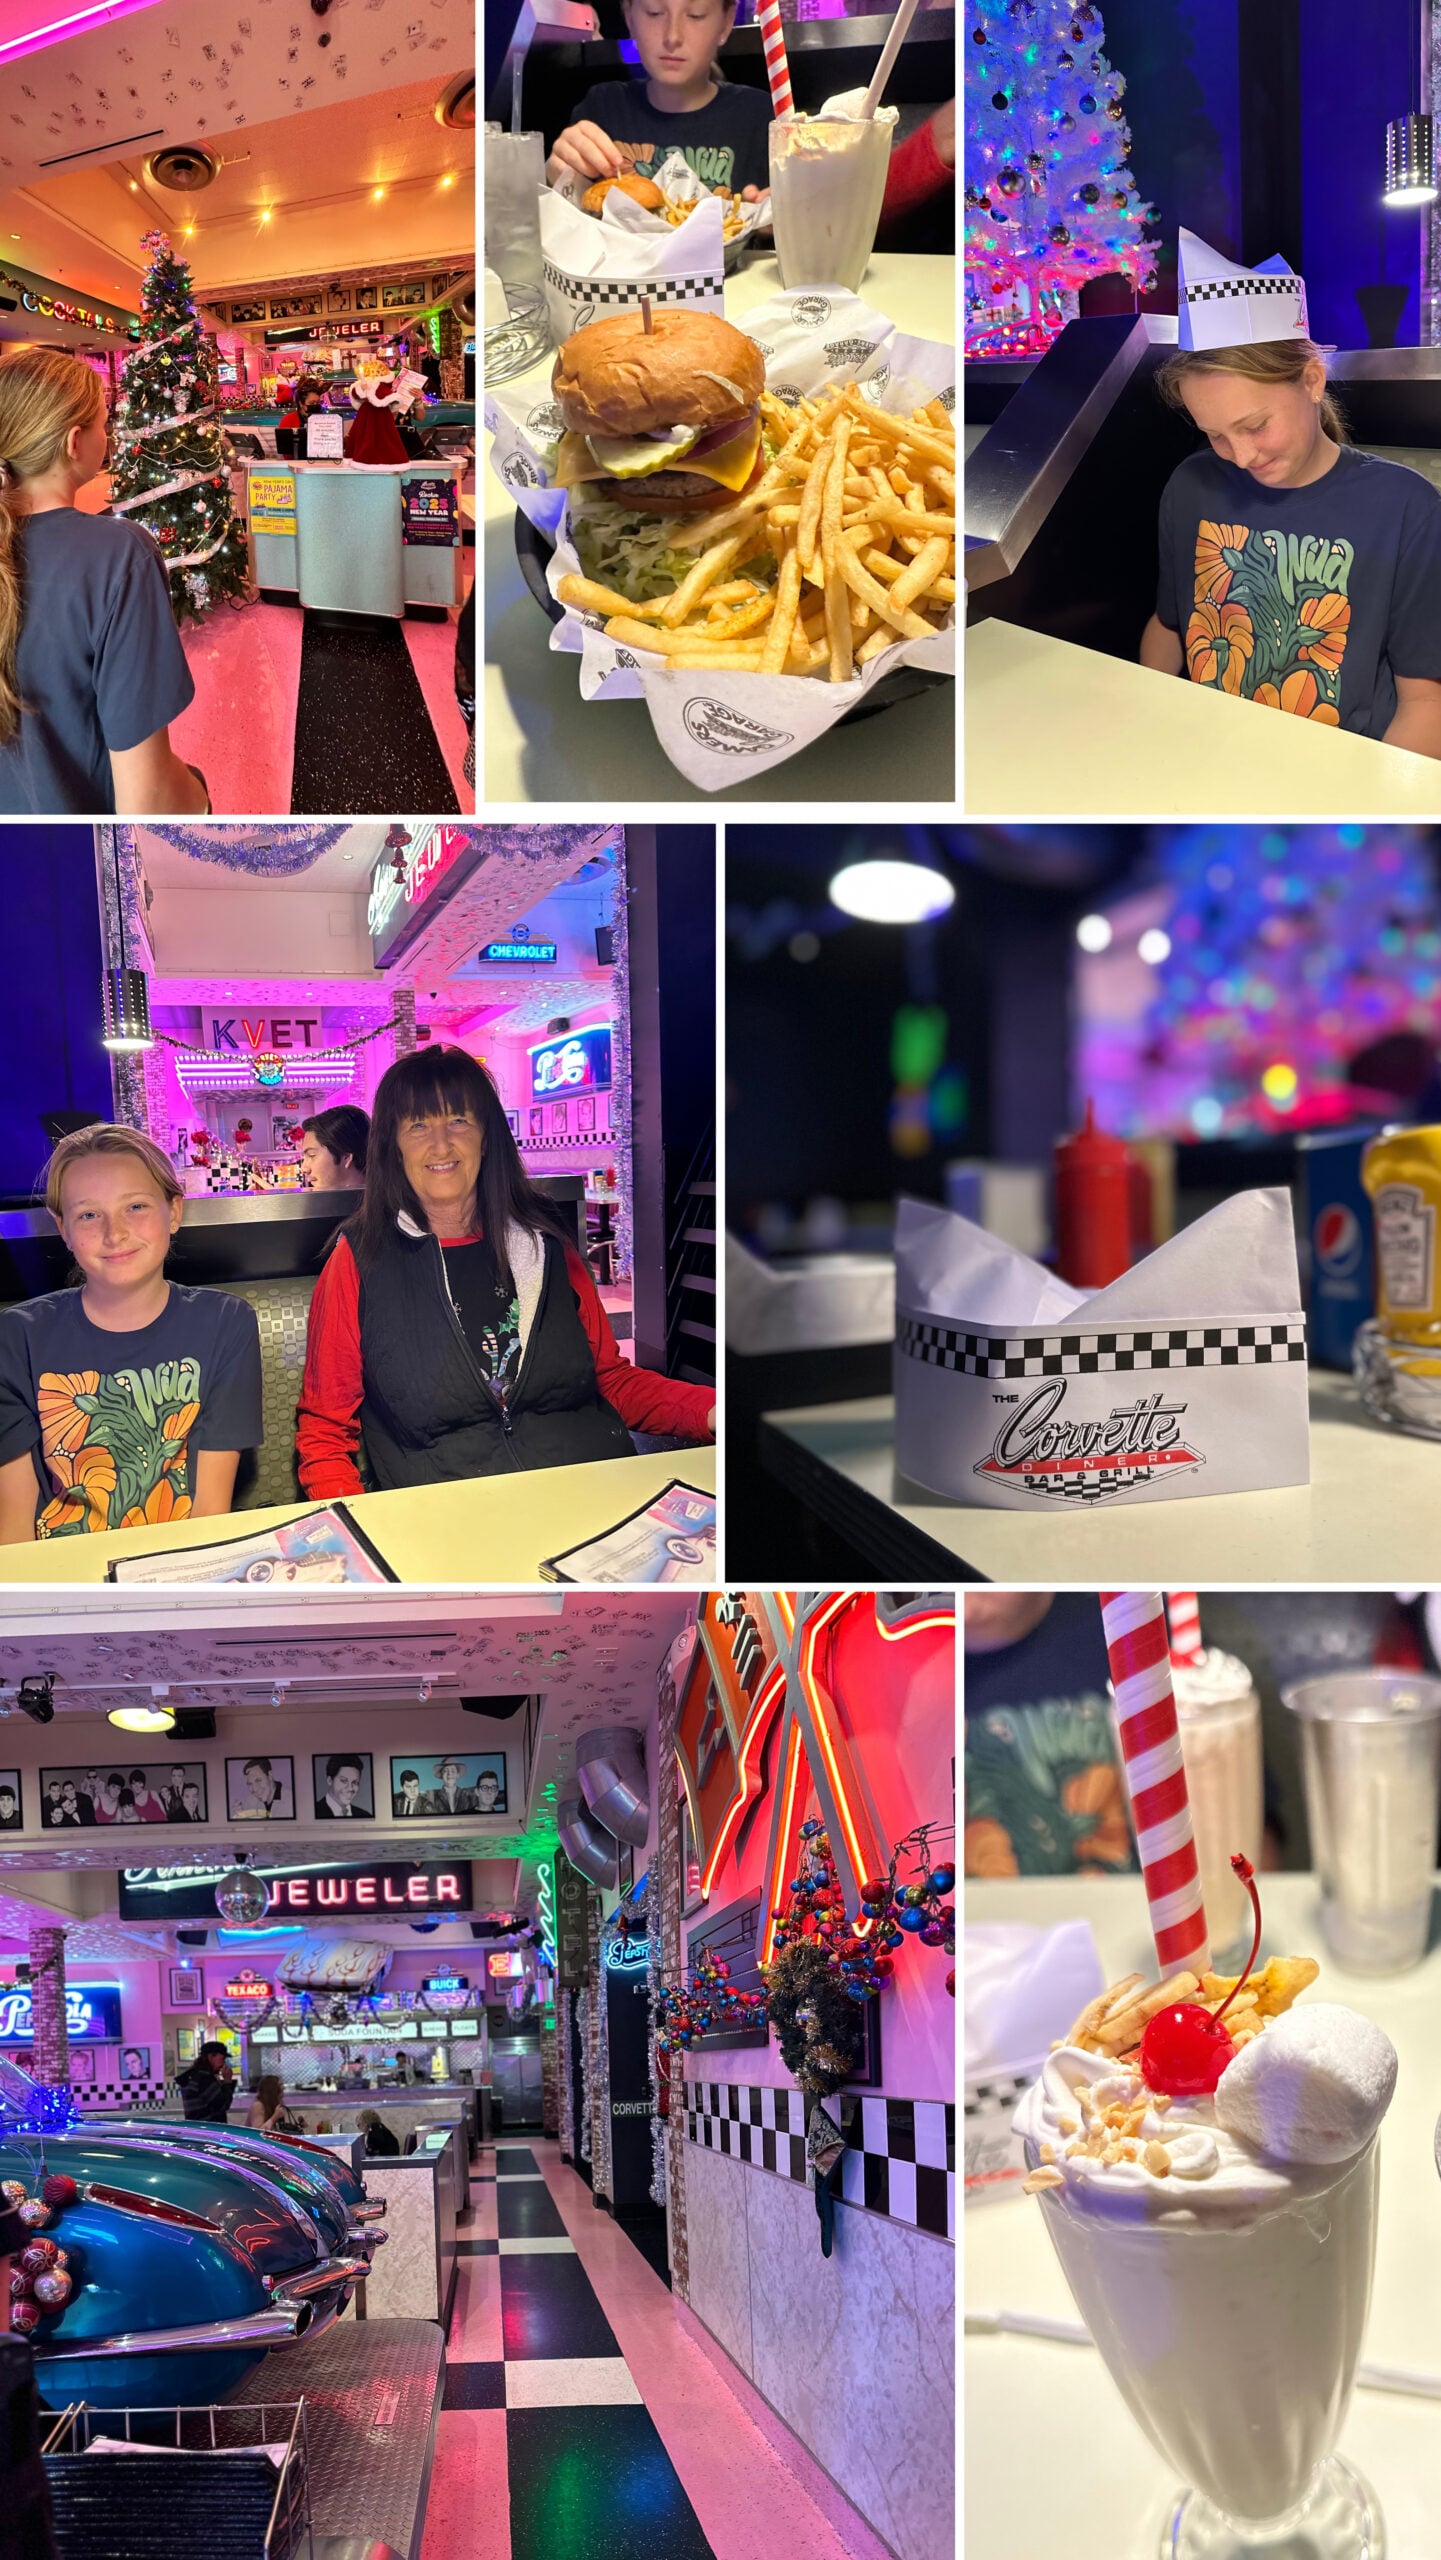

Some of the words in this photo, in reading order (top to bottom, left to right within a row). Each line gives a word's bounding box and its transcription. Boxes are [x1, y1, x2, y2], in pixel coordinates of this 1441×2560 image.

[256, 493, 276, 501] PARTY
[263, 484, 293, 494] PAJAMA
[409, 498, 449, 510] 2025
[1263, 529, 1355, 606] Wild
[708, 702, 783, 738] GARAGE
[488, 945, 556, 959] CHEVROLET
[212, 1019, 318, 1049] KVET
[112, 1356, 201, 1429] Wild
[992, 1394, 1020, 1404] THE
[992, 1376, 1189, 1470] Corvette
[1021, 1454, 1159, 1473] DINER
[1024, 1472, 1064, 1484] BAR
[1076, 1471, 1087, 1481] &
[1099, 1465, 1155, 1478] GRILL
[266, 1874, 462, 1906] JEWELER
[226, 1984, 269, 1997] TEXACO
[429, 1979, 460, 1991] BUICK
[612, 2102, 657, 2115] CORVETT
